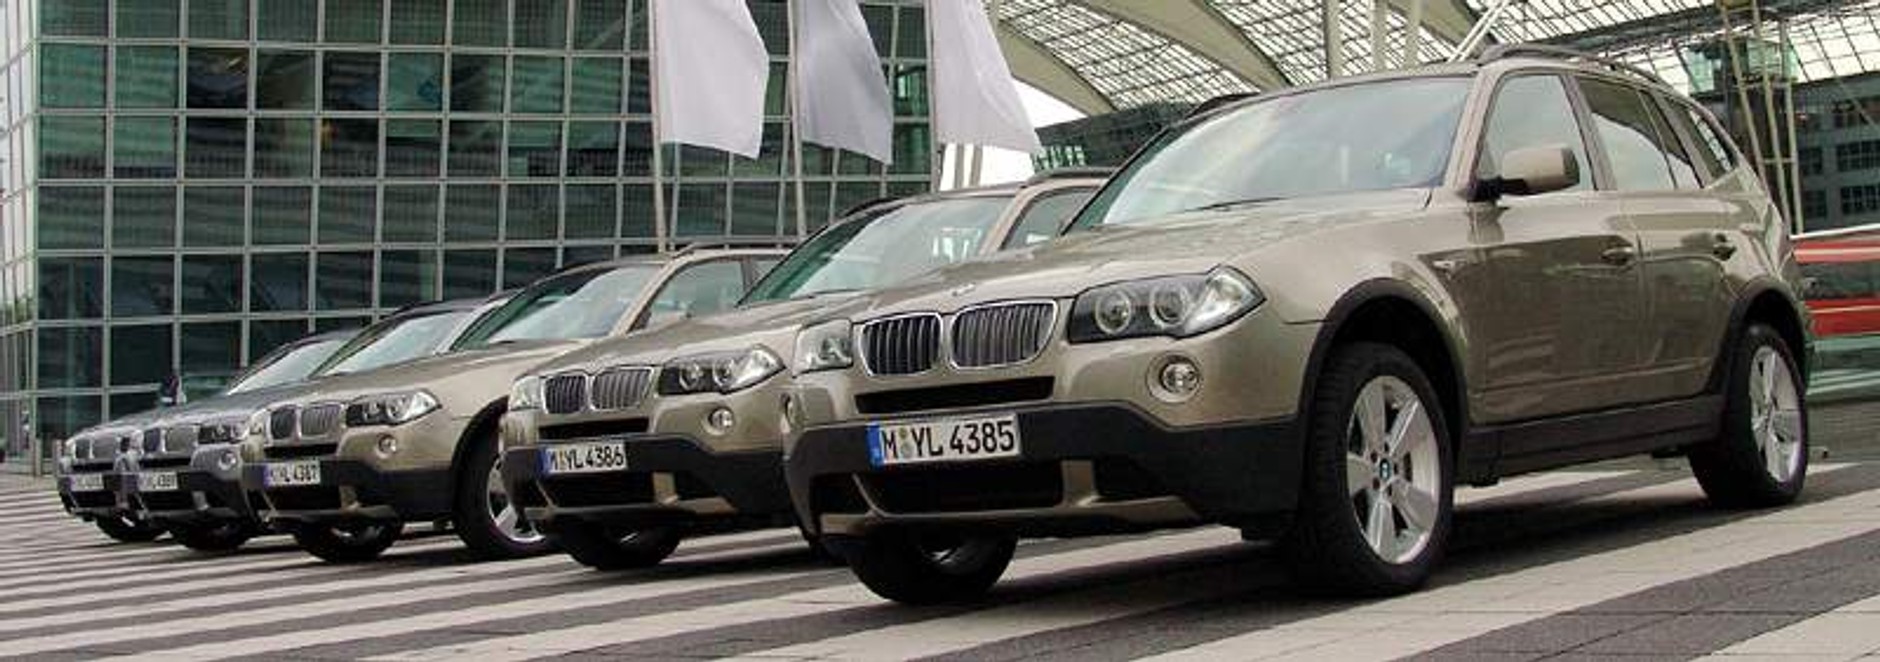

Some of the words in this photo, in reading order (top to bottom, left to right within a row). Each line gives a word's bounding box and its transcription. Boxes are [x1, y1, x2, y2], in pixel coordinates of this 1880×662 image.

[881, 428, 899, 459] M
[911, 426, 944, 457] YL
[950, 420, 1015, 454] 4385
[565, 448, 584, 470] YL
[586, 445, 624, 468] 4386
